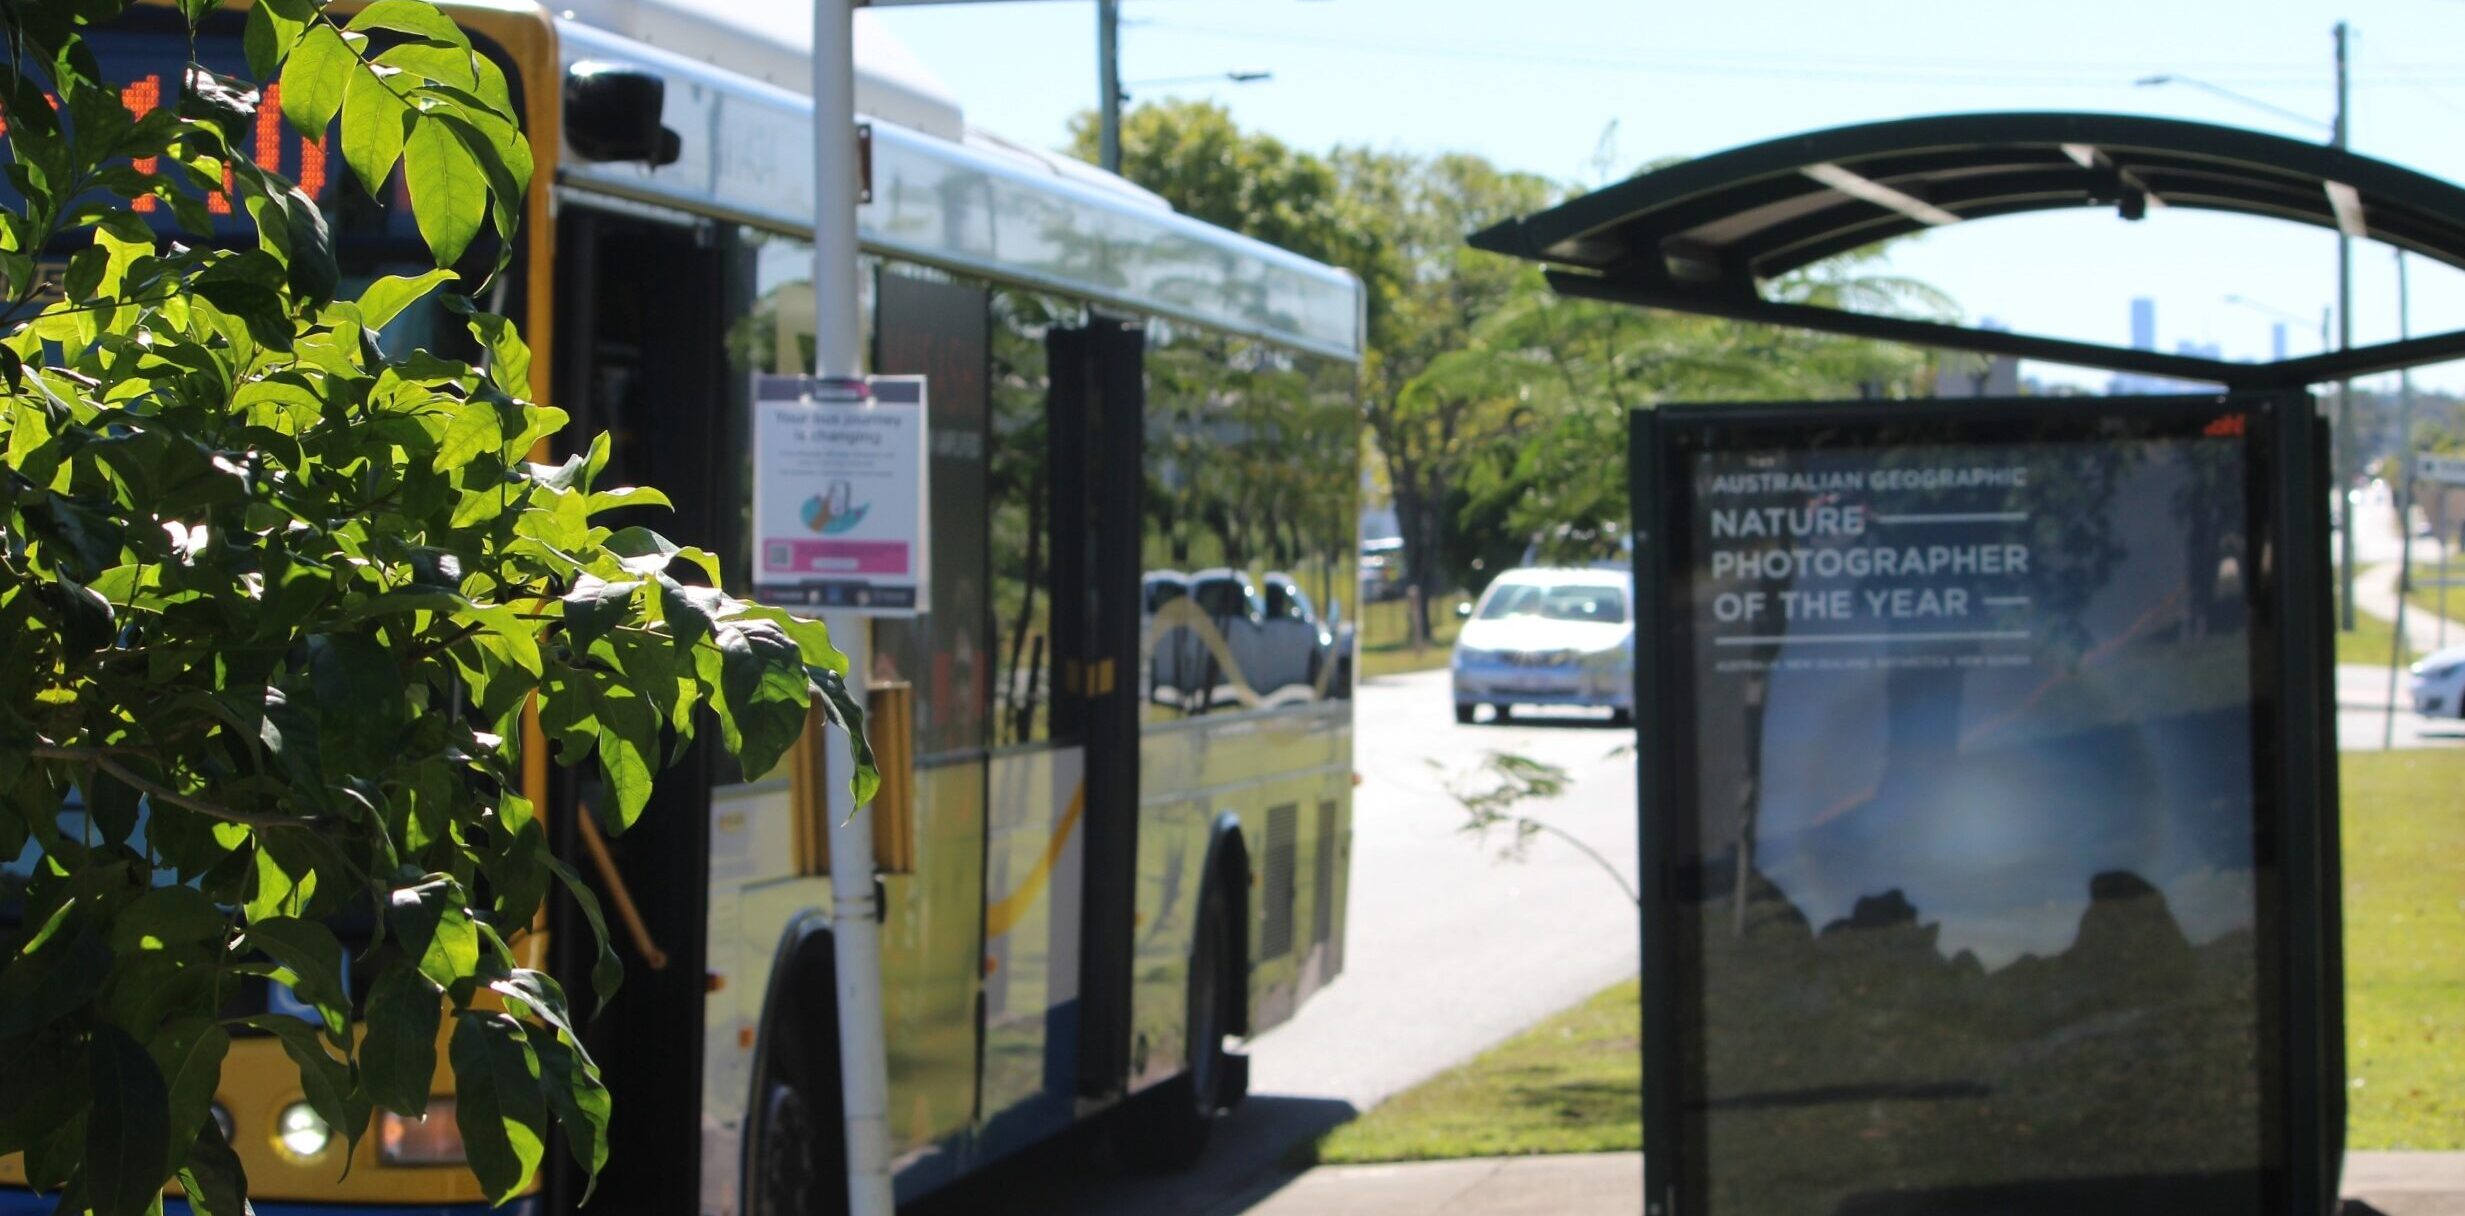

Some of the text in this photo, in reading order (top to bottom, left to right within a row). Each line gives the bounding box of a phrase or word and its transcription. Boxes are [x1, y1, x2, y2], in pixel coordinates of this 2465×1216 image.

[774, 410, 902, 429] Your bus journey
[793, 429, 882, 446] is changing
[1711, 466, 2029, 494] AUSTRALIAN GEOGRAPHIC
[1710, 506, 1866, 538] NATURE
[1712, 543, 2029, 580] PHOTOGRAPHER
[1713, 586, 1969, 622] OF THE YEAR
